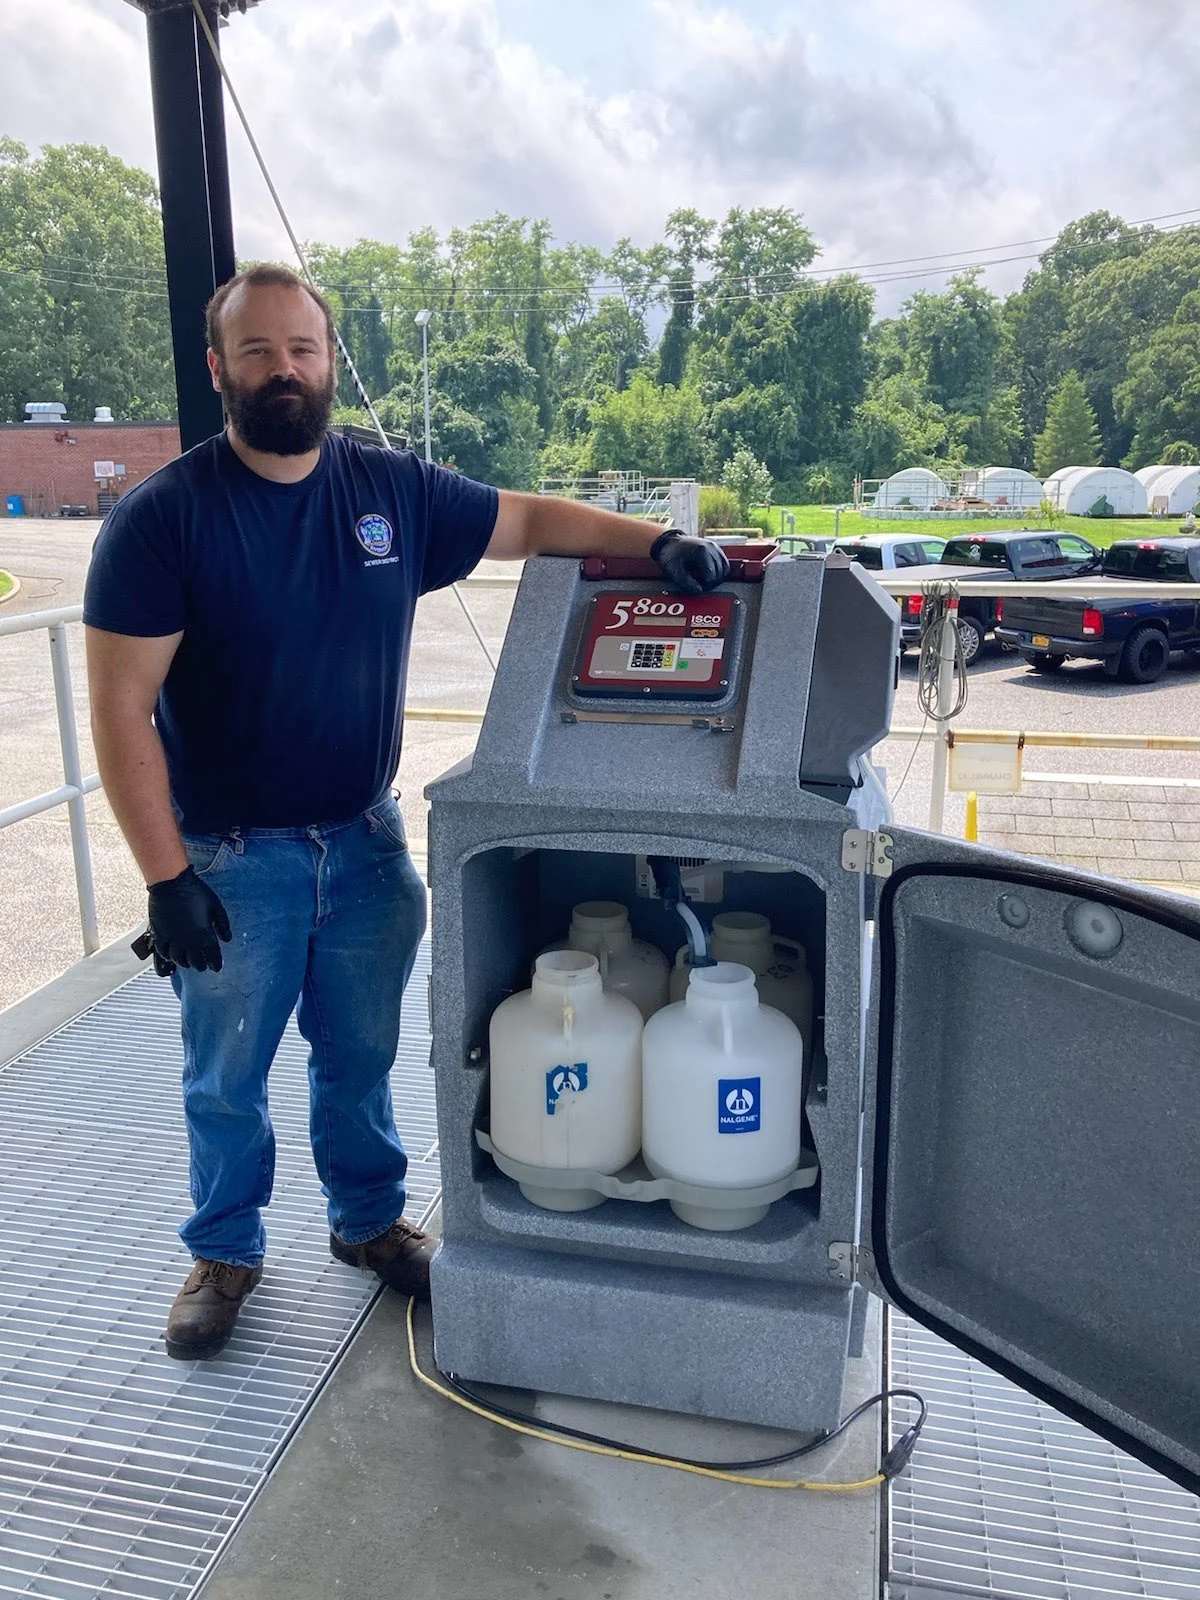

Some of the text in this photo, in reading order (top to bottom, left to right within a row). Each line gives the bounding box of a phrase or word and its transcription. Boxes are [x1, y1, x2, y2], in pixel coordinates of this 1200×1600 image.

[604, 597, 685, 630] 5800
[691, 615, 721, 624] ISCO
[720, 1115, 756, 1124] NALGENE
